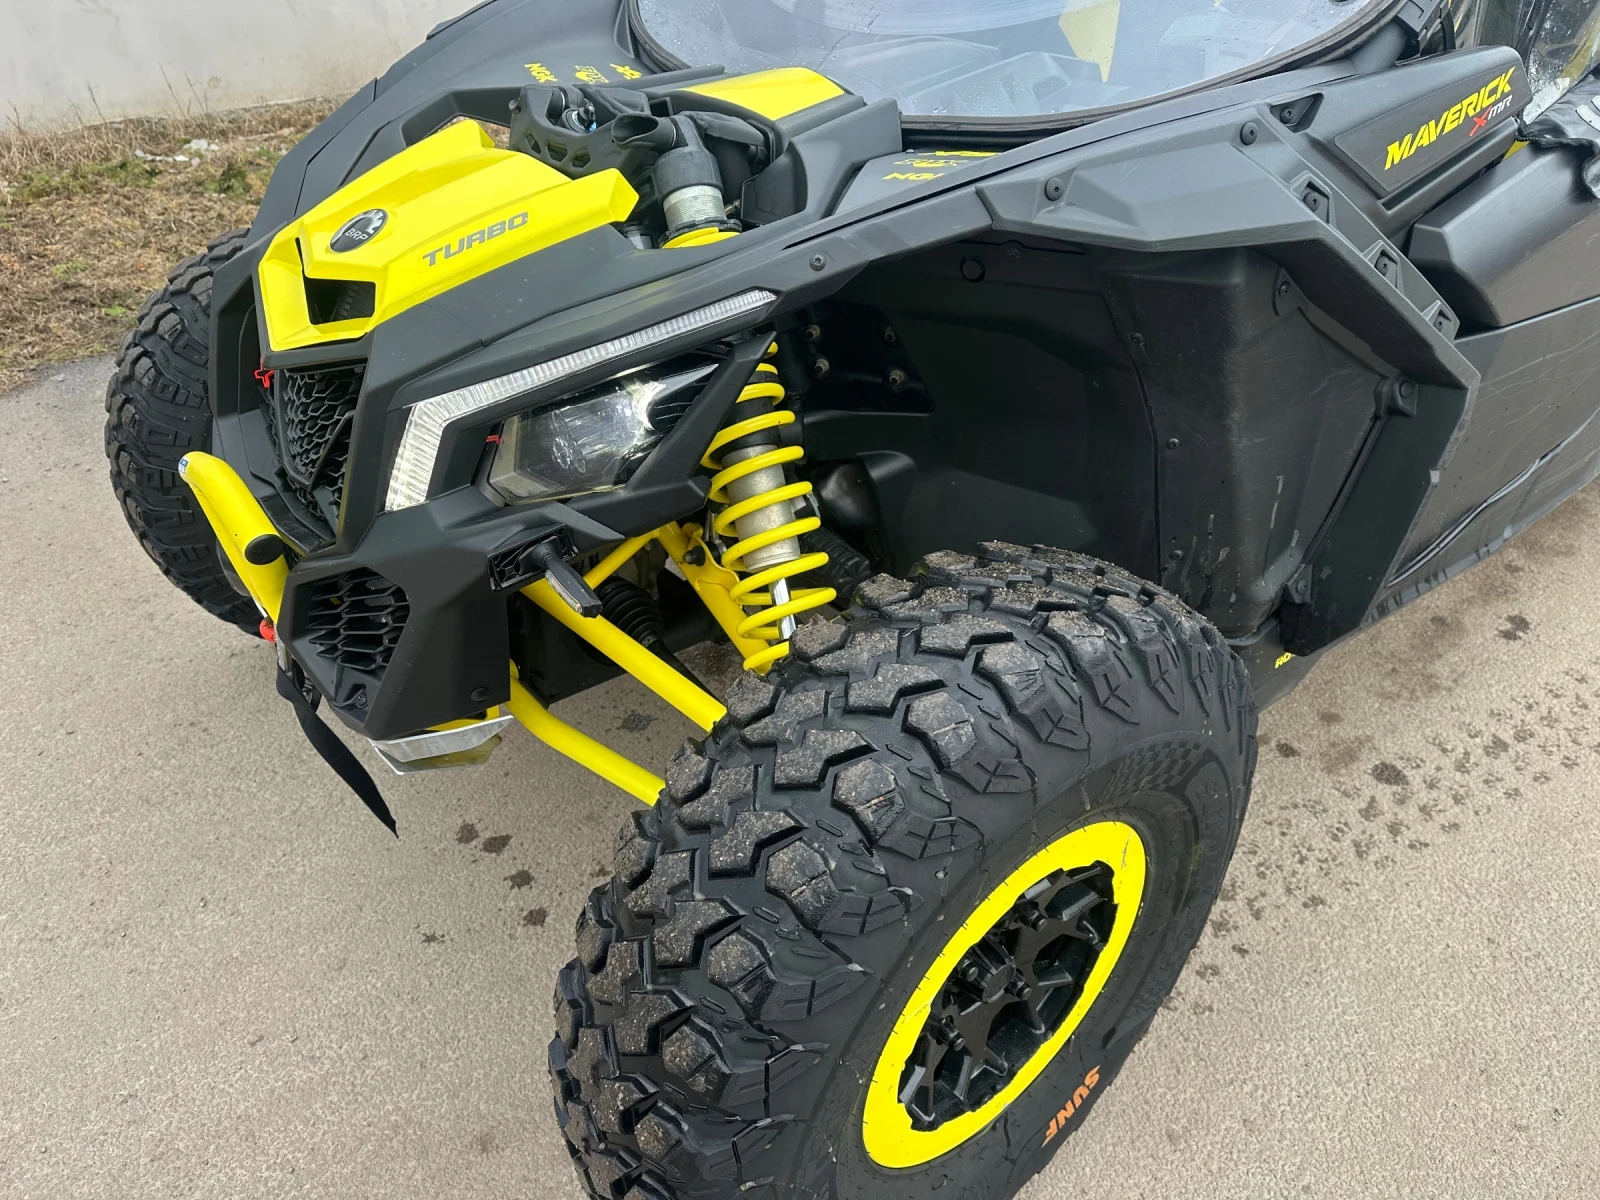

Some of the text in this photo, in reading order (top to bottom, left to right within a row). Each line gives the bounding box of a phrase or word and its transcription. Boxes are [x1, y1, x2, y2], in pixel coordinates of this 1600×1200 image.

[524, 62, 558, 83] NGK
[1384, 66, 1516, 171] MAVERICK
[345, 228, 368, 241] BRP
[422, 211, 529, 268] TURBO
[1041, 1064, 1101, 1148] SUNF
